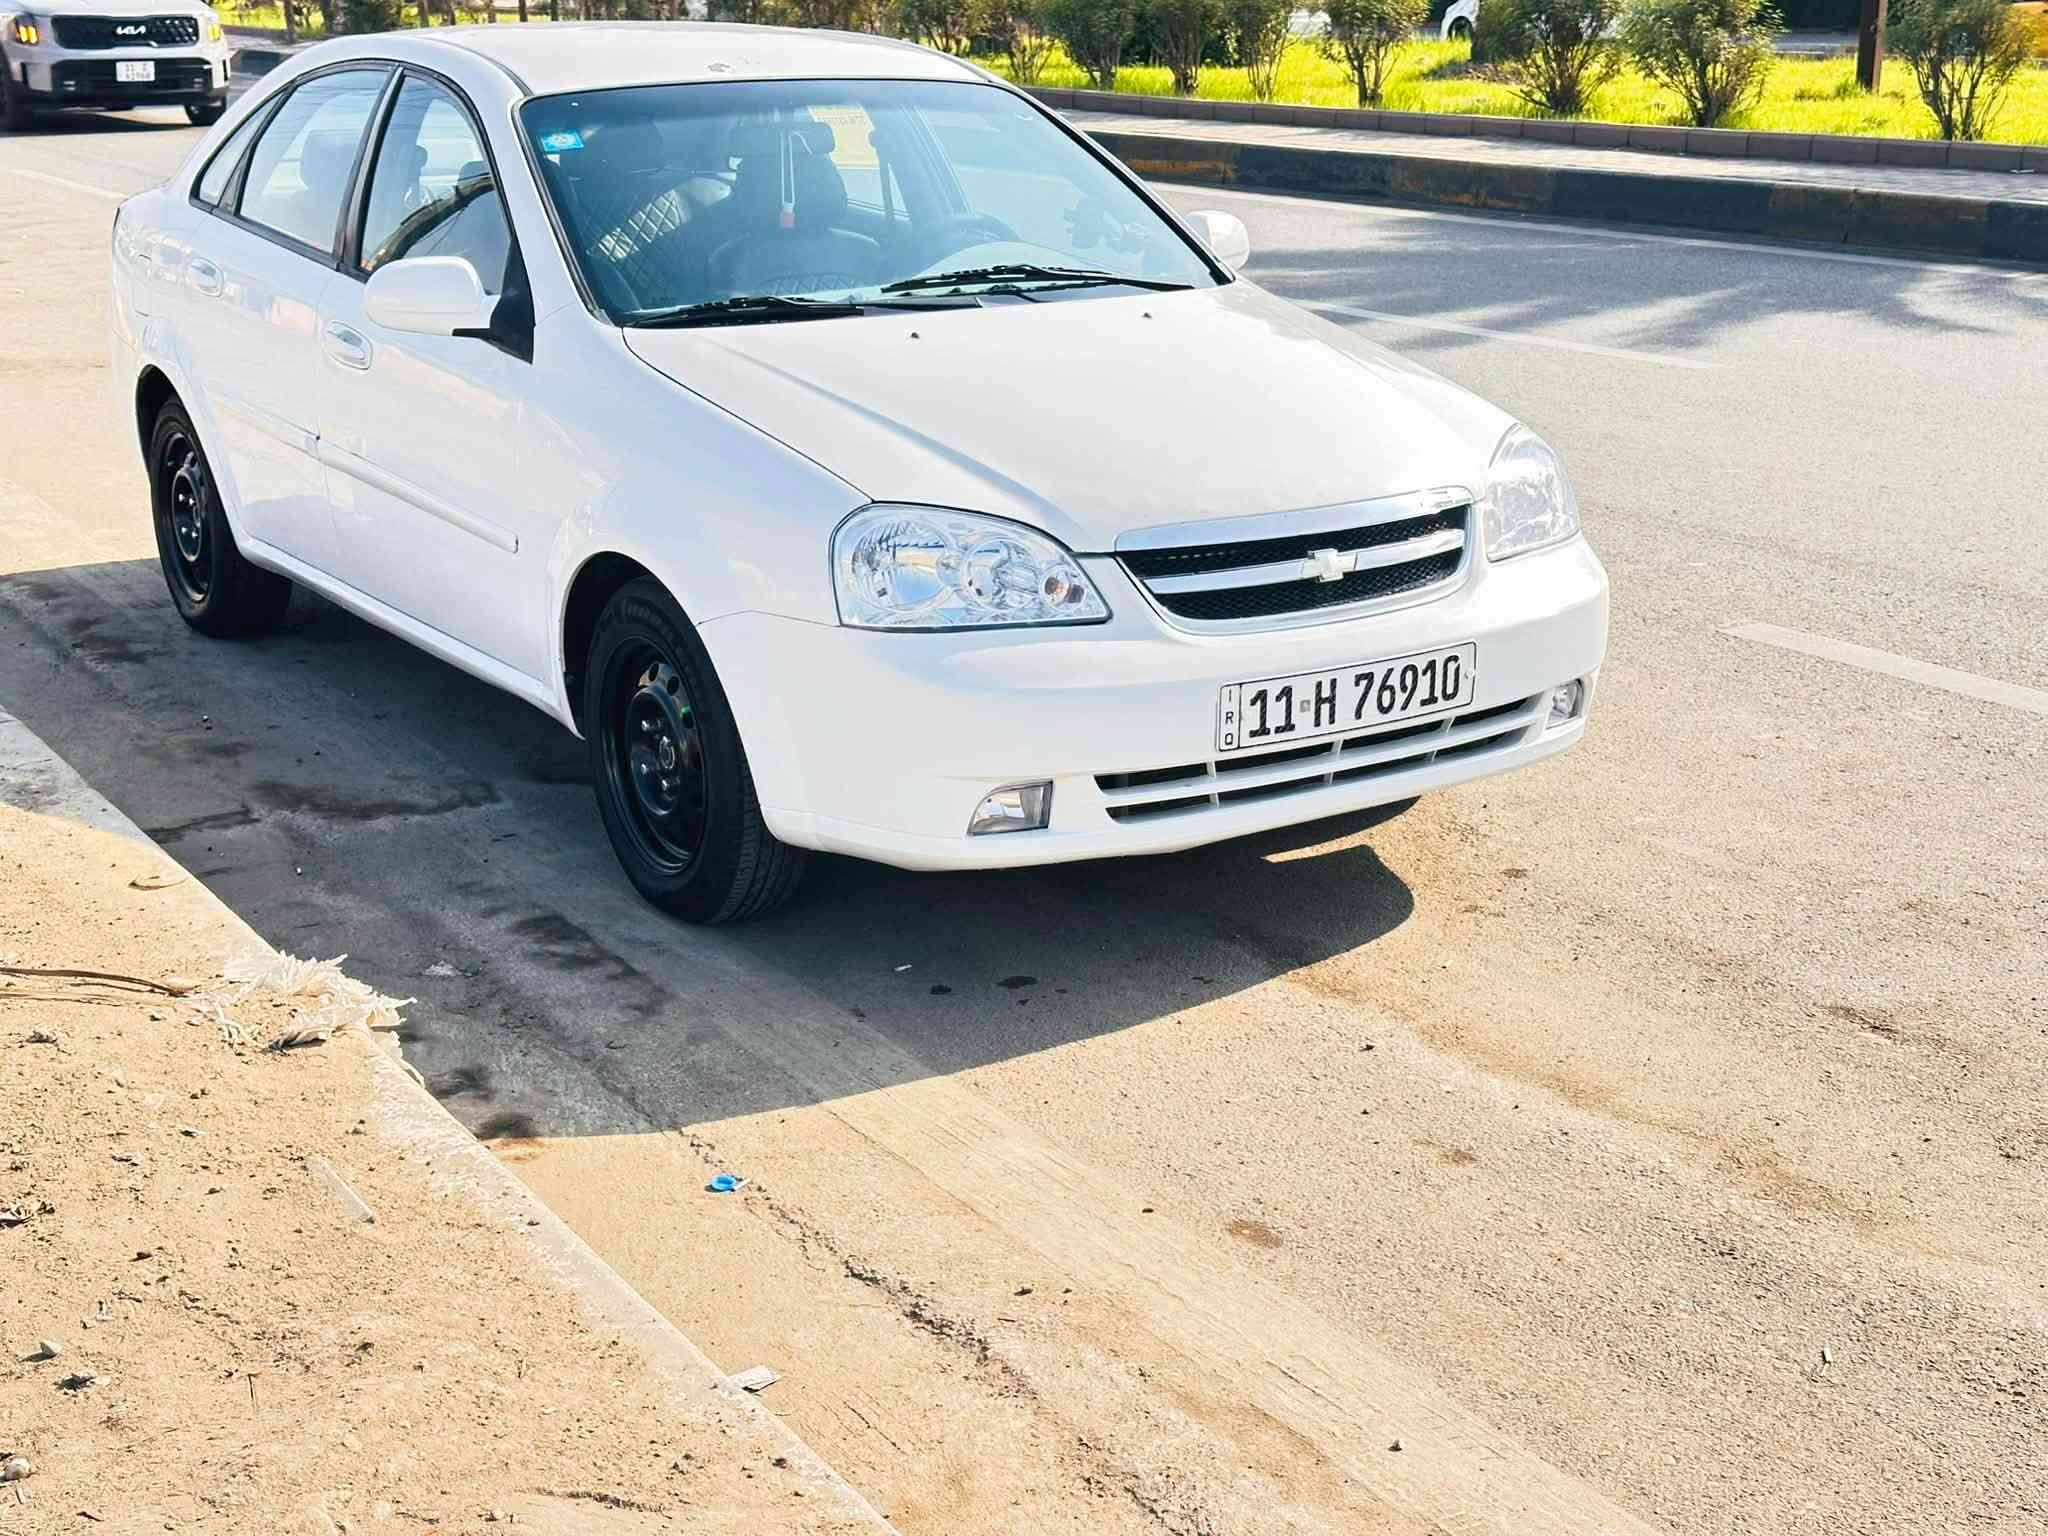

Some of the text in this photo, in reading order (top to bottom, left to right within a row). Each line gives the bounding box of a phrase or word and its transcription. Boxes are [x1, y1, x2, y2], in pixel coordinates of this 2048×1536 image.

[1249, 654, 1460, 738] 11 H 76910
